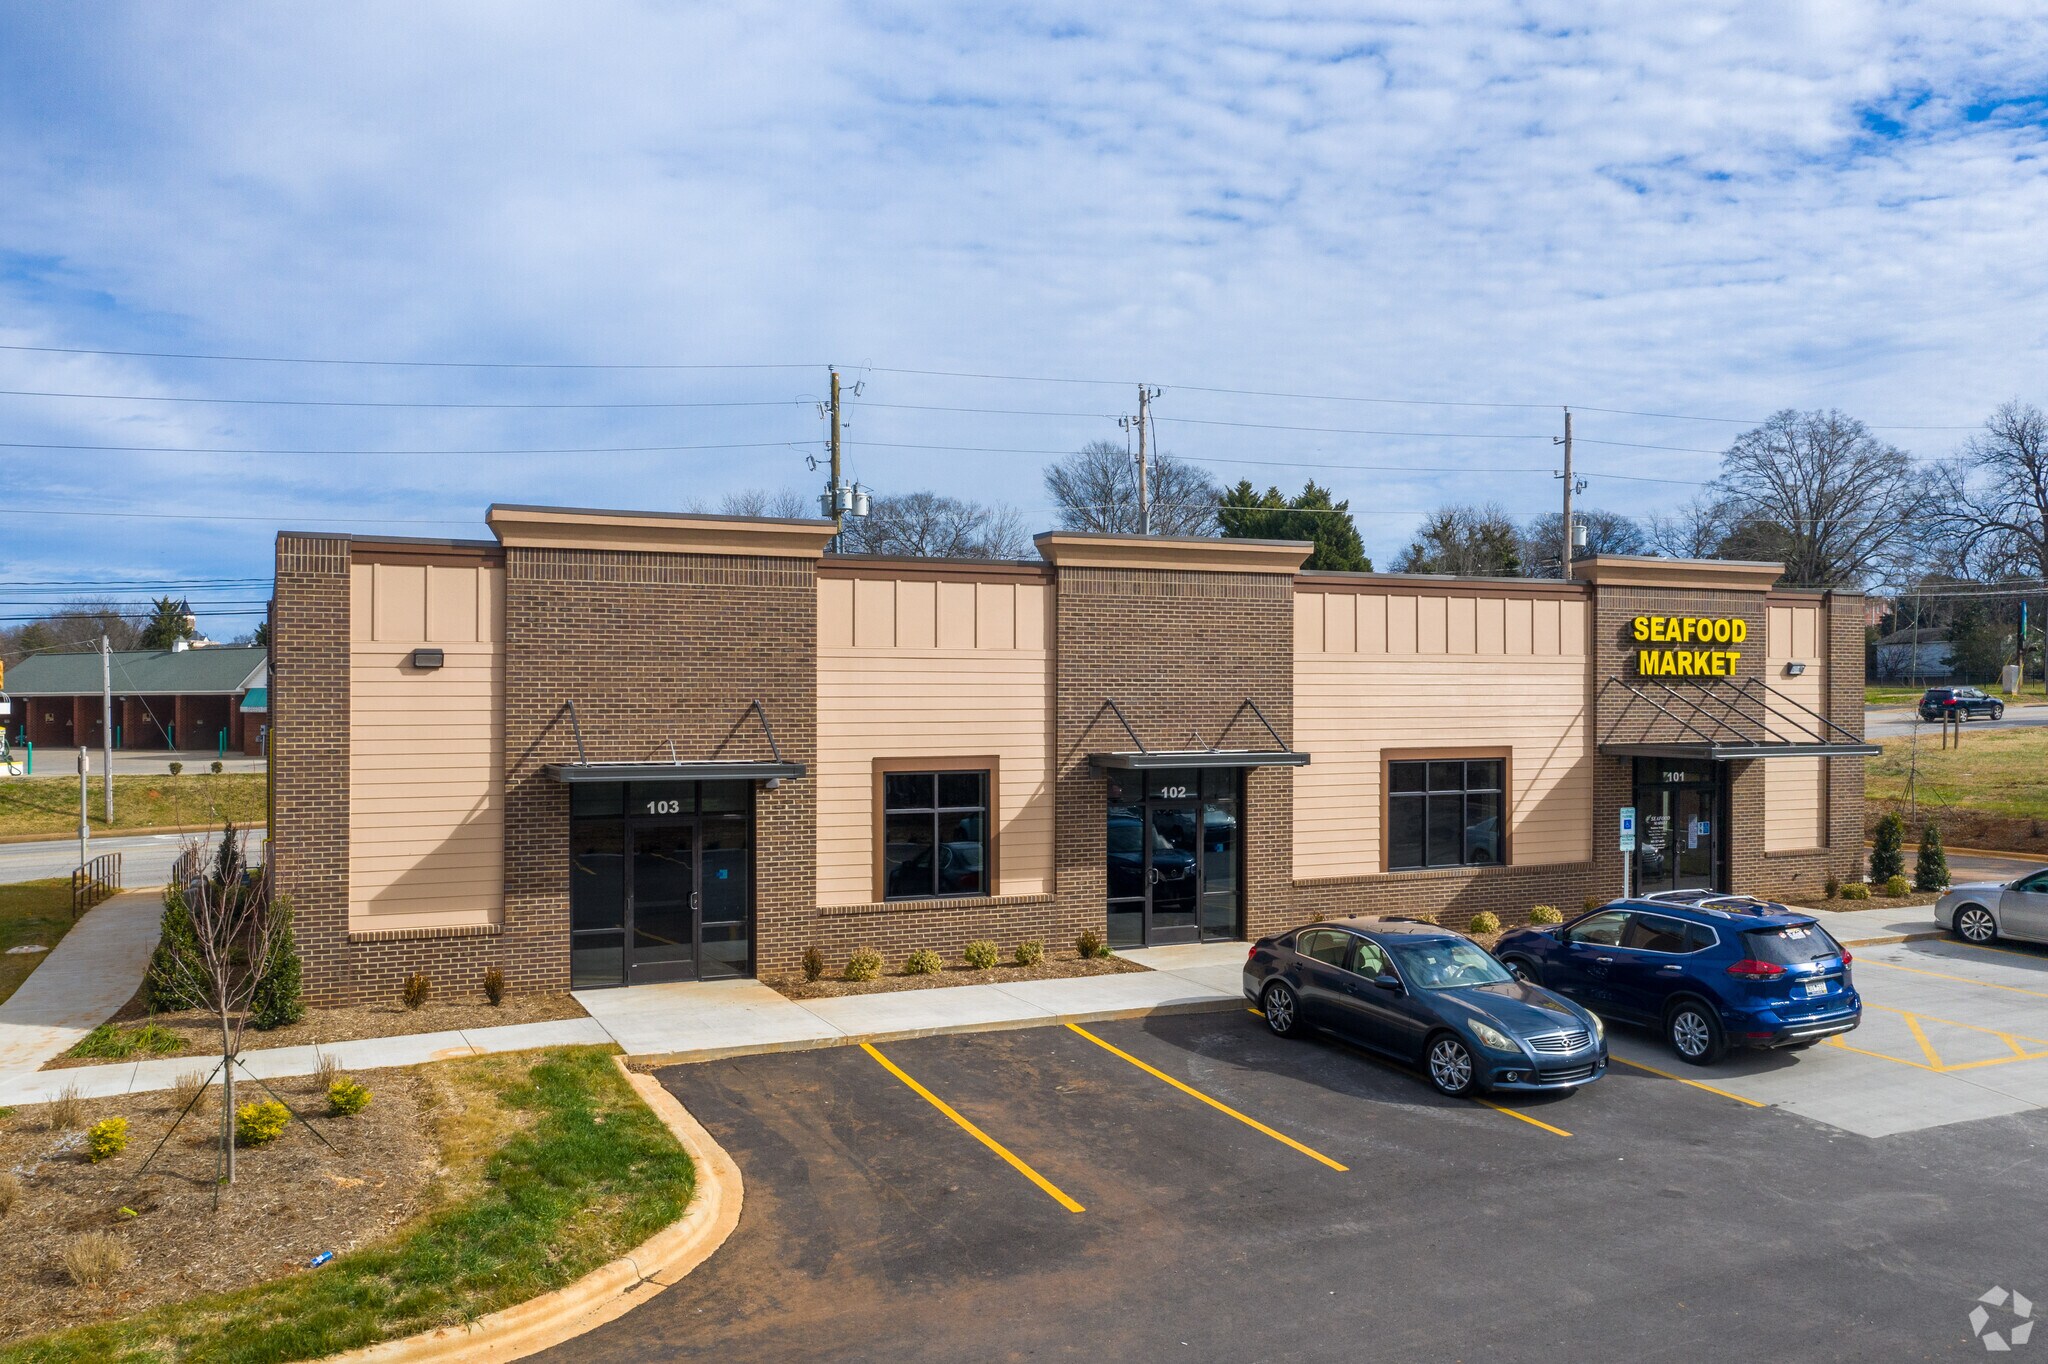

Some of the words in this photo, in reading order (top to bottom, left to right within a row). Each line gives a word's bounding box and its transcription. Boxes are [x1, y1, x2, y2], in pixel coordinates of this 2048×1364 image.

[1633, 616, 1747, 643] SEAFOOD
[1639, 650, 1741, 676] MARKET
[1667, 771, 1685, 782] 101
[1161, 786, 1186, 799] 102
[646, 800, 680, 815] 103
